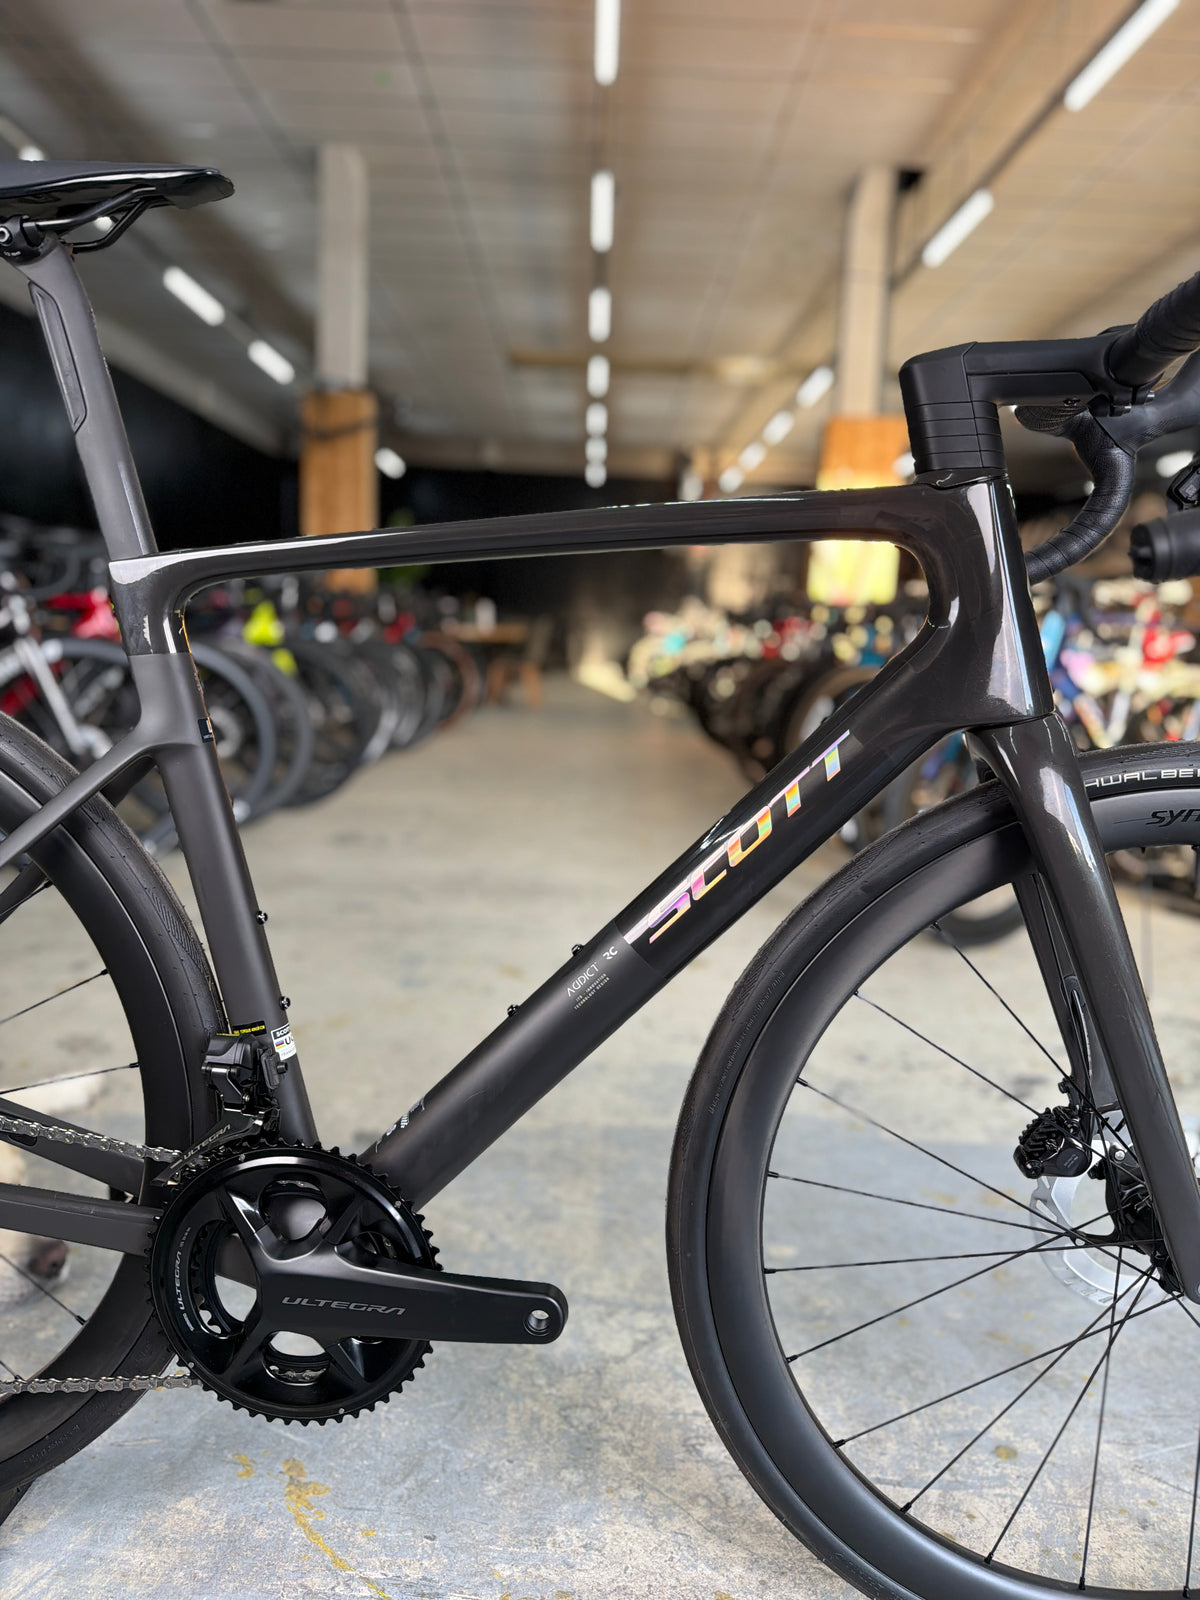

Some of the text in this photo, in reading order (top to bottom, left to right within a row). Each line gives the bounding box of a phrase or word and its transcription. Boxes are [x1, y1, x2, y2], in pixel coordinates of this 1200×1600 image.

[1084, 768, 1194, 788] HWALBE
[624, 729, 850, 944] SCOTT
[567, 946, 618, 997] ADDICT RC
[183, 1124, 231, 1160] ULTEGRA
[175, 1251, 185, 1311] ULTEGRA
[282, 1296, 406, 1316] ULTEGRA
